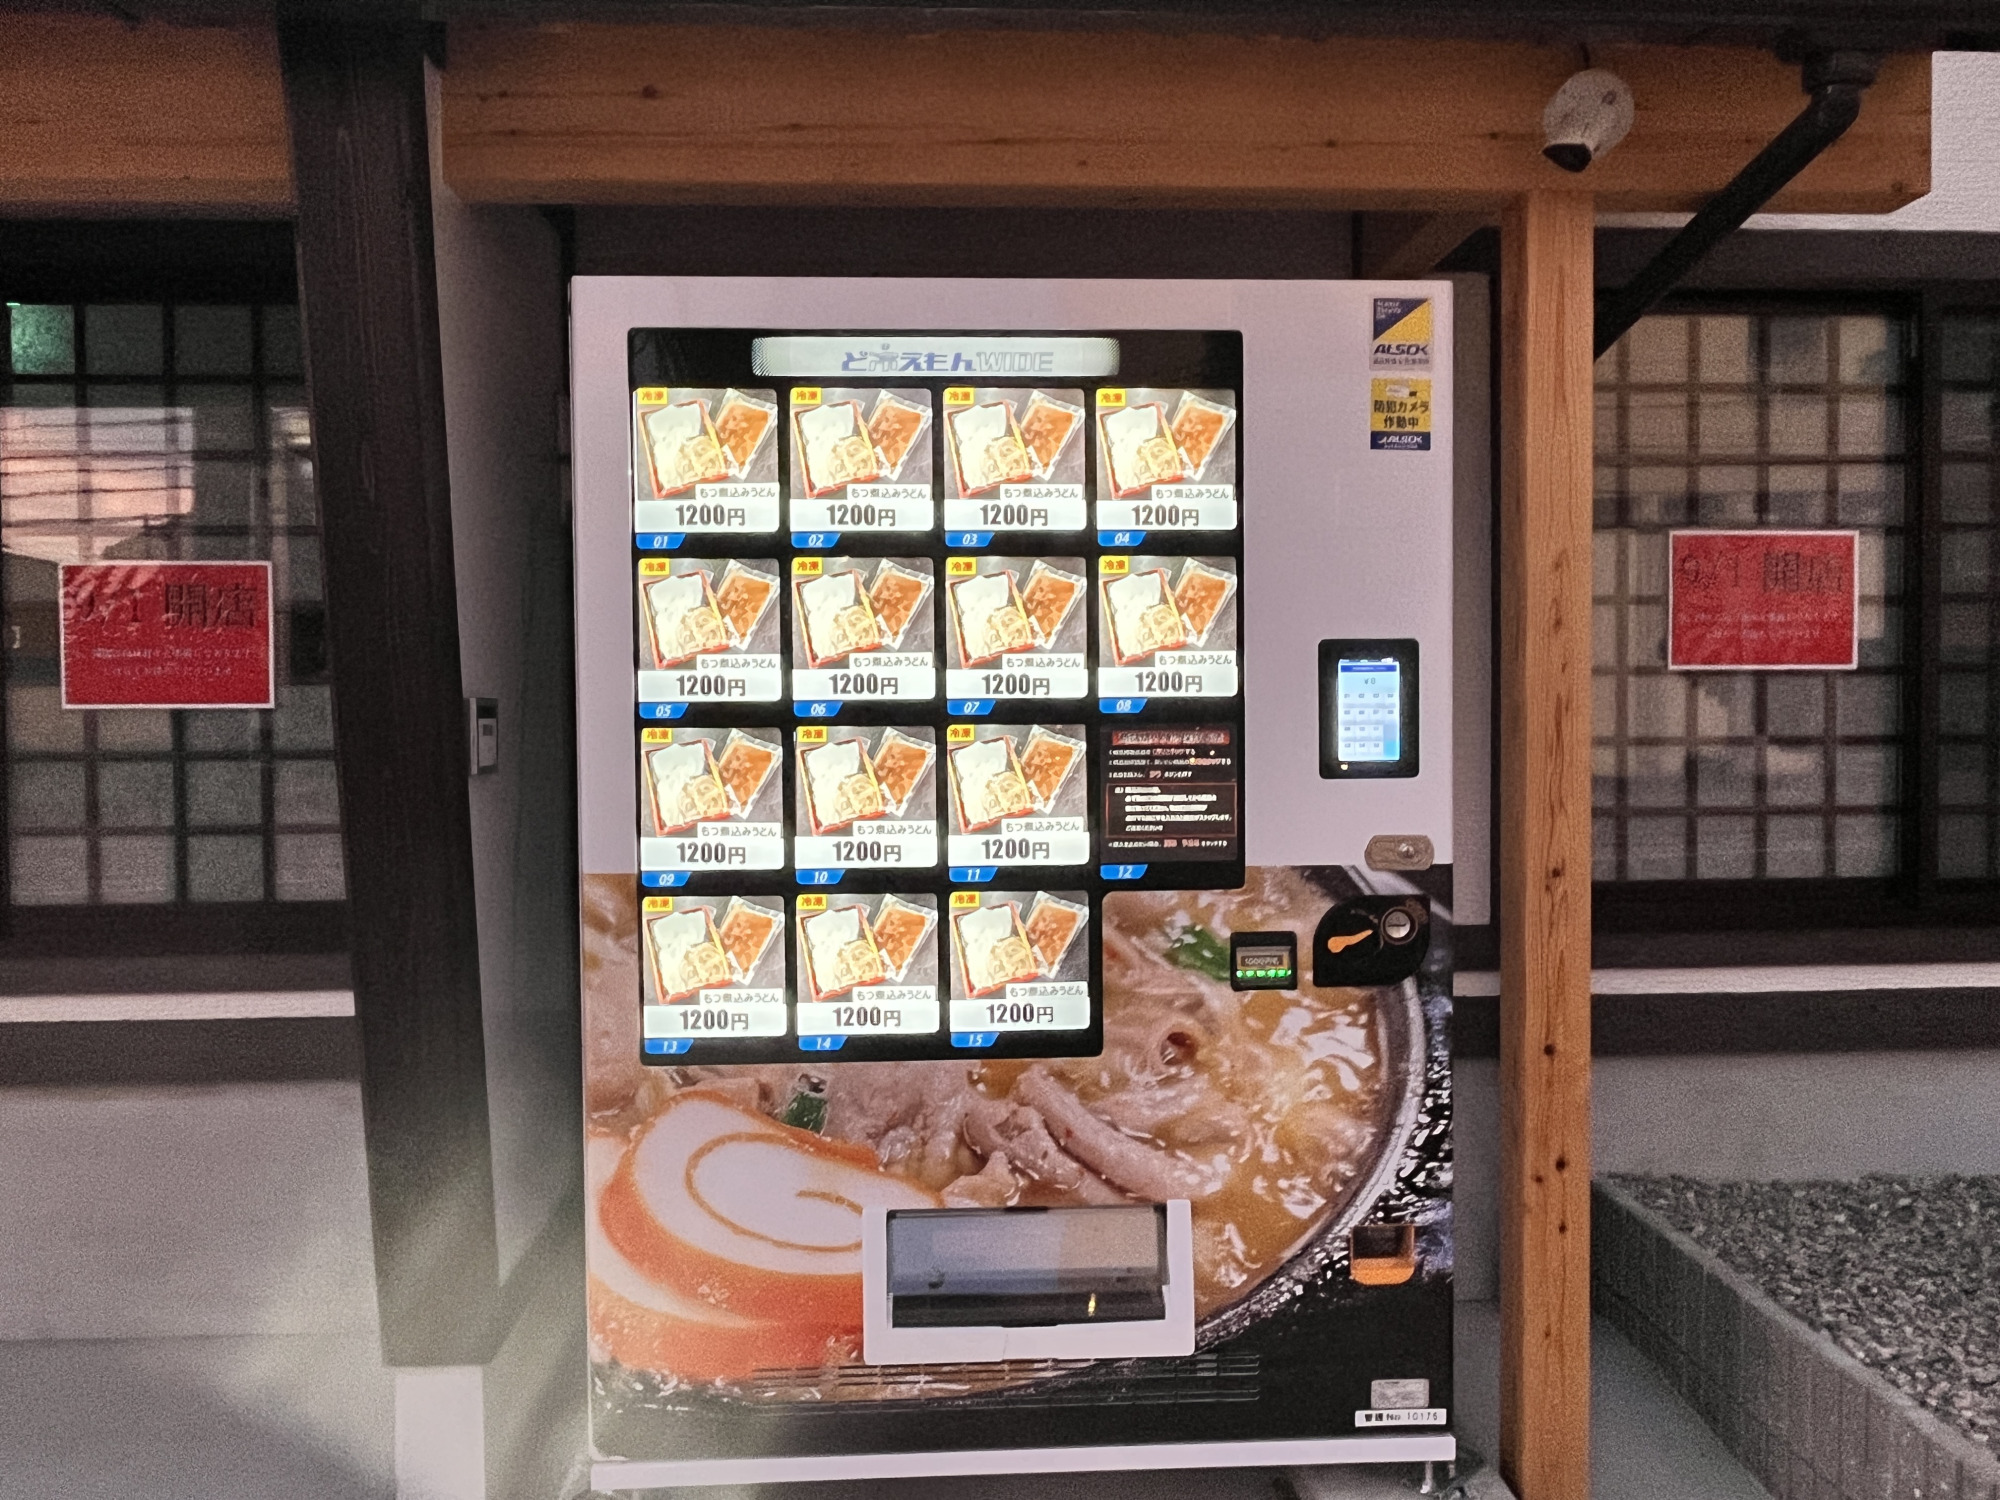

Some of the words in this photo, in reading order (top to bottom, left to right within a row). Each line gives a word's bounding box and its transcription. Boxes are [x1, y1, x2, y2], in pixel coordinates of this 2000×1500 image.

[1373, 343, 1428, 356] ALSOK
[1374, 400, 1429, 414] 防犯カメラ
[1383, 415, 1419, 429] 作動中
[676, 504, 746, 526] 1200円
[826, 504, 896, 527] 1200円
[980, 504, 1048, 526] 1200円
[1131, 504, 1199, 526] 1200円
[653, 535, 668, 548] 01
[808, 534, 824, 547] 02
[962, 533, 977, 545] 03
[1114, 532, 1130, 544] 04
[165, 583, 257, 628] 開店
[676, 675, 746, 697] 1200円
[829, 673, 898, 695] 1200円
[981, 673, 1050, 695] 1200円
[1135, 671, 1202, 693] 1200円
[655, 704, 671, 717] 05
[811, 703, 826, 715] 06
[963, 701, 980, 714] 07
[1116, 700, 1131, 712] 08
[676, 842, 746, 865] 1200円
[832, 841, 902, 862] 1200円
[981, 838, 1050, 860] 1200円
[814, 871, 828, 883] 10
[967, 868, 980, 881] 11
[1117, 865, 1132, 878] 12
[659, 873, 675, 886] 09
[680, 1009, 749, 1031] 1200円
[833, 1006, 901, 1027] 1200円
[986, 1003, 1054, 1024] 1200円
[816, 1037, 832, 1049] 14
[968, 1033, 983, 1046] 15
